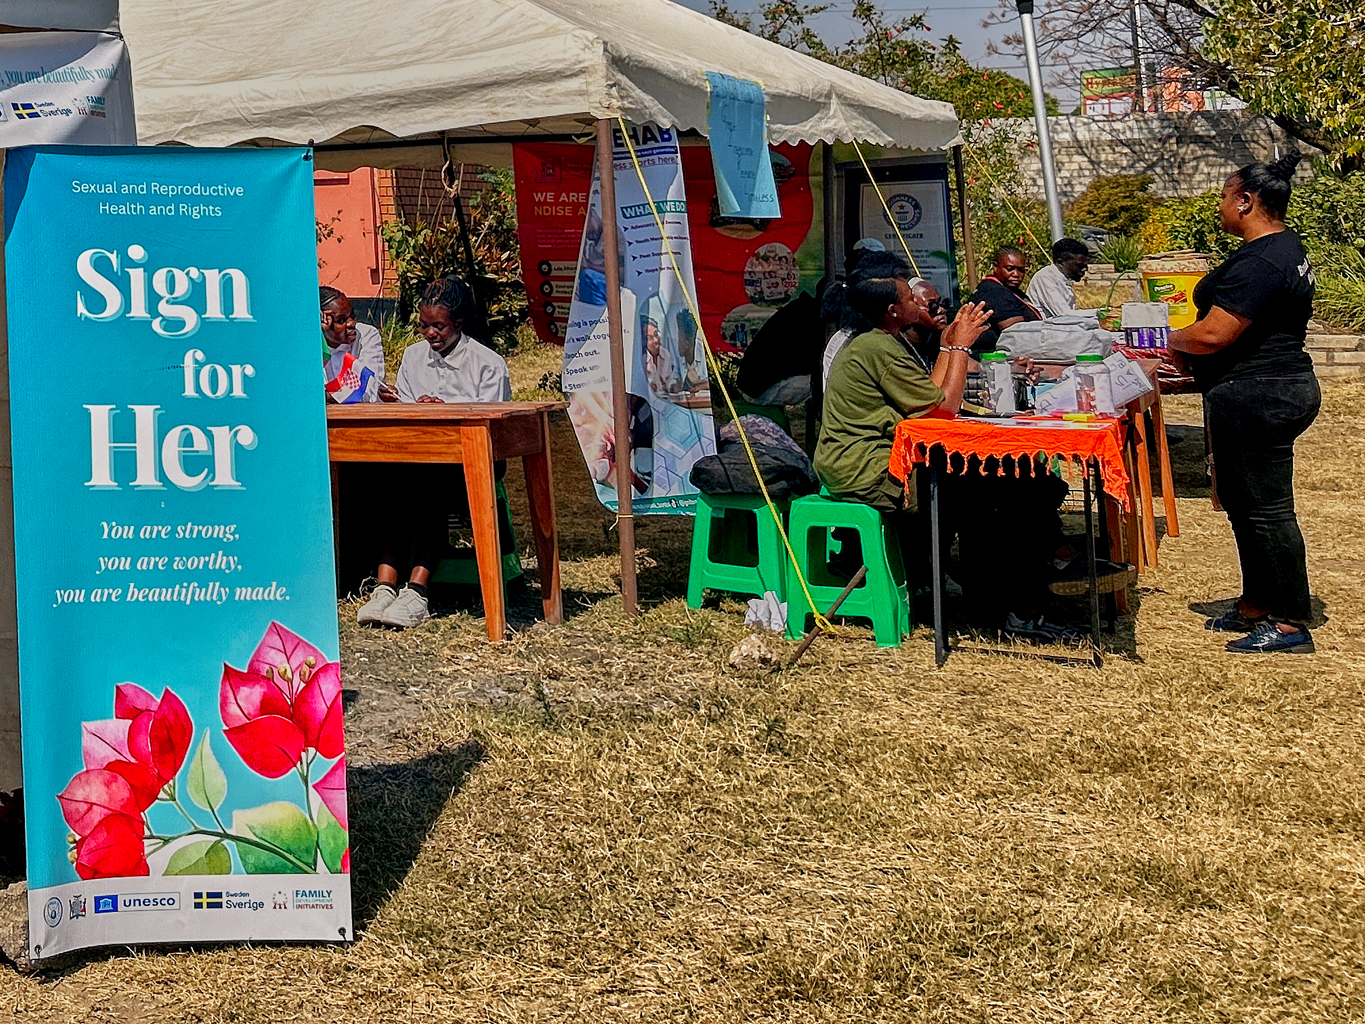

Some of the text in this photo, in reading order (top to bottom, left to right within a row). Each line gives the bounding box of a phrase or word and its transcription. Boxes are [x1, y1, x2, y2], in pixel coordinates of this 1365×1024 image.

[6, 69, 23, 87] you
[26, 71, 41, 83] are
[40, 66, 94, 84] beautifully
[39, 108, 73, 118] Sverige
[612, 125, 672, 148] EHAB
[71, 180, 244, 198] Sexual and Reproductive
[533, 192, 587, 203] WE ARE
[99, 202, 222, 219] Health and Rights
[623, 201, 685, 217] WHA WE DO
[76, 244, 256, 338] Sign
[576, 334, 591, 342] walk
[182, 348, 255, 398] for
[83, 404, 257, 490] Her
[100, 521, 240, 542] You are strong,
[95, 551, 242, 574] you are worthy,
[52, 581, 291, 608] you are beautifully made.
[123, 897, 176, 908] unesco
[295, 889, 332, 898] FAMILY
[225, 900, 265, 911] Sverige
